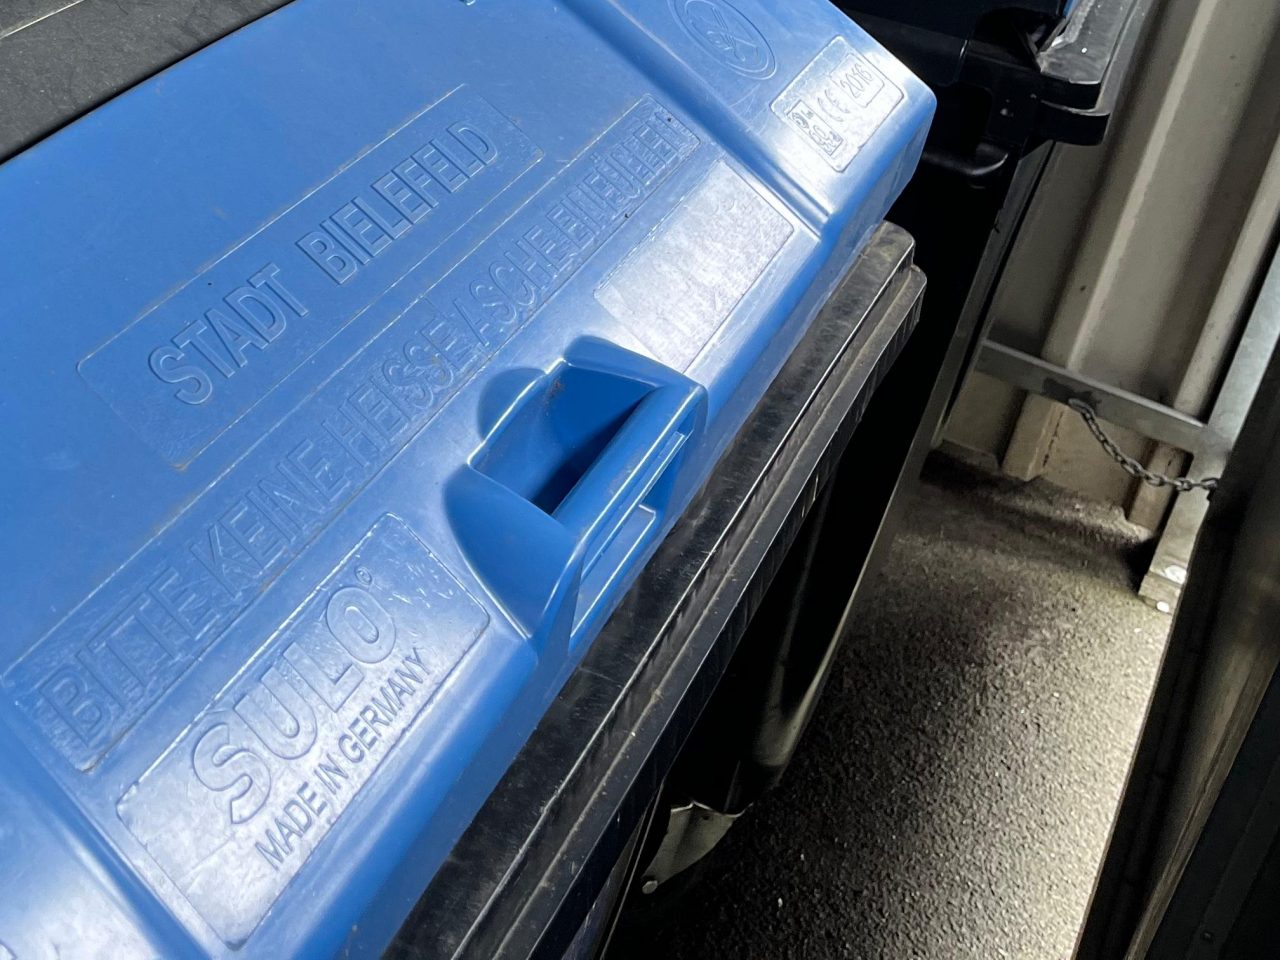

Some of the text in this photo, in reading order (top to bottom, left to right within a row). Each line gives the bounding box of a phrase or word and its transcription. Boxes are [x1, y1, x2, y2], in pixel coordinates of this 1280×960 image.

[840, 62, 873, 99] 2016
[147, 120, 499, 406] STADT BIELEFELD
[36, 564, 221, 748] BITTE
[187, 436, 353, 600] KEINE
[319, 315, 479, 470] HEISSE
[442, 222, 575, 349] ASCHE
[254, 646, 431, 871] MADE IN GERMANY
